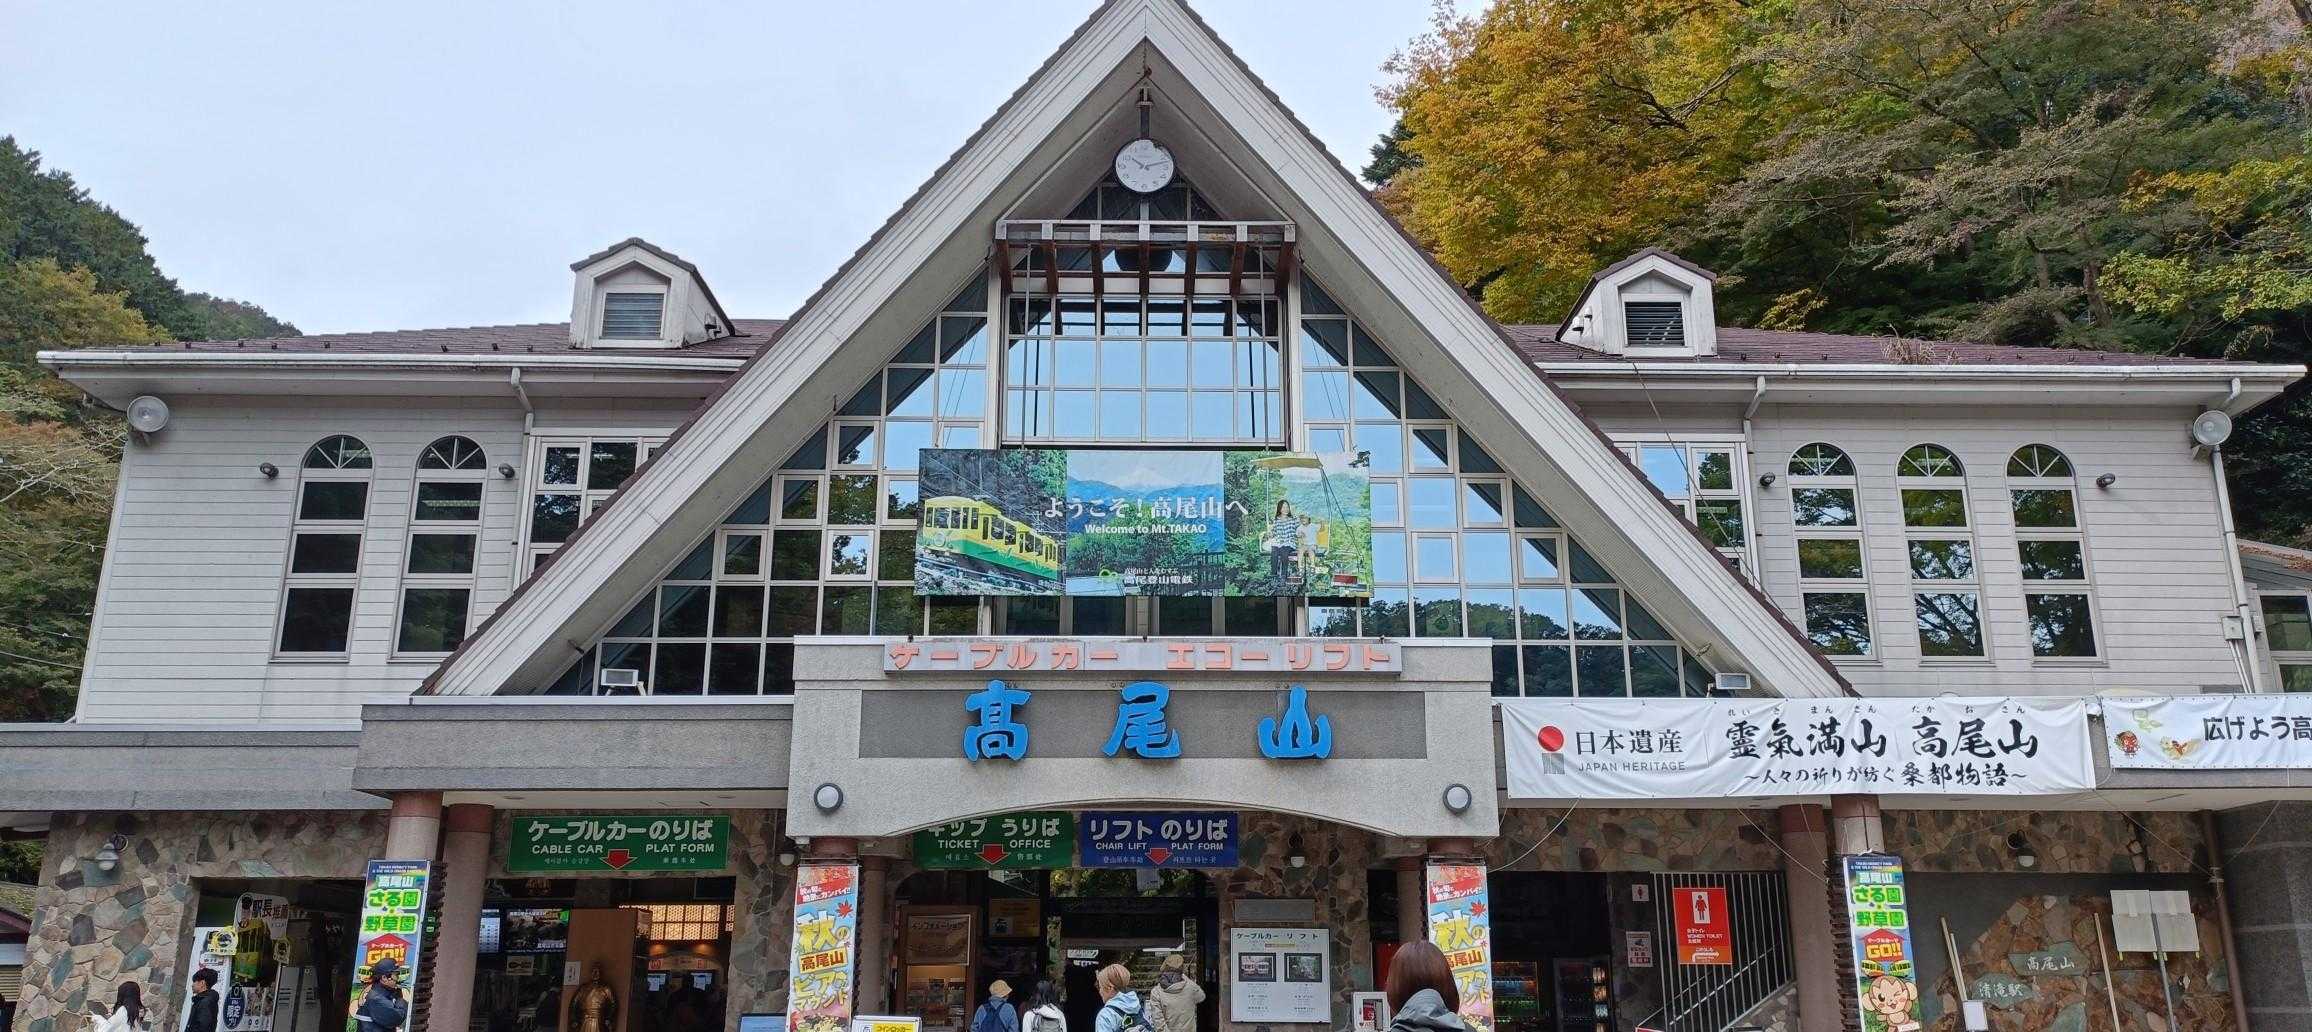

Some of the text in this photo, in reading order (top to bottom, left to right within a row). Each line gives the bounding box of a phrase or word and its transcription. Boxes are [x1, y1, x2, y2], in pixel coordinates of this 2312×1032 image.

[1085, 523, 1207, 534] Welcome to Mt.TAKAO
[1124, 575, 1194, 585] 高尾登山電鉄
[889, 643, 1118, 671] ケーブルカー
[1576, 728, 1684, 755] 日本遺産
[1911, 715, 2038, 759] 高尾山
[1578, 761, 1686, 772] JAPAN HERITAGE
[528, 820, 713, 841] ケーブルカーのりば
[1001, 818, 1060, 838] うりば
[1090, 818, 1229, 841] リフト のりば
[532, 843, 715, 854] CABLE CAR PLAT FORM
[938, 839, 1052, 849] TICKET OFFICE
[1095, 842, 1224, 850] CHAIR LIFT PLAT FORM
[368, 889, 419, 908] さる園
[1854, 887, 1902, 903] さる園
[363, 915, 416, 932] 野草園
[1855, 911, 1905, 927] 野草園
[796, 910, 851, 951] 秋の
[1430, 909, 1486, 951] 秋の
[800, 950, 844, 971] 高尾山
[2027, 956, 2075, 971] 高尾山
